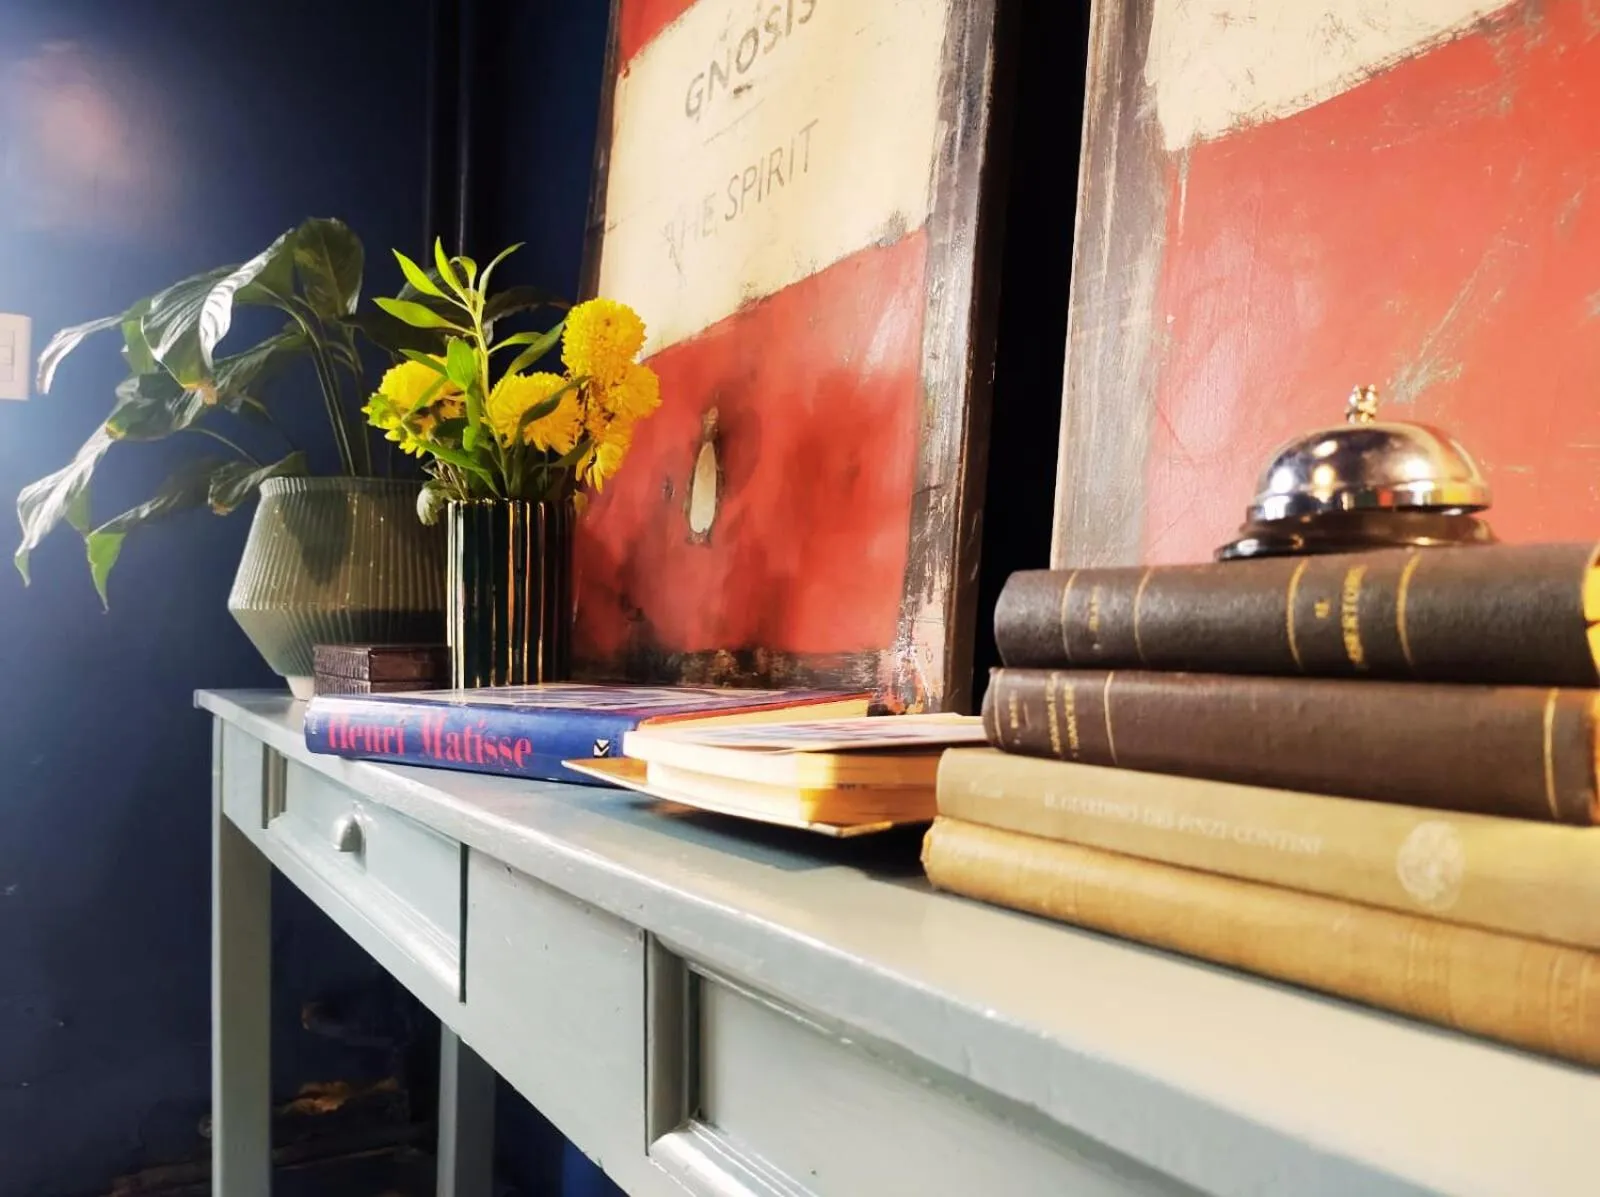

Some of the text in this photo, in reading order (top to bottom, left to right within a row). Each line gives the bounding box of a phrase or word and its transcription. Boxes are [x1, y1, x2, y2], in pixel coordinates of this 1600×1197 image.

[724, 118, 819, 222] SPIRIT
[328, 710, 406, 757] Henri
[420, 708, 534, 769] Matisse
